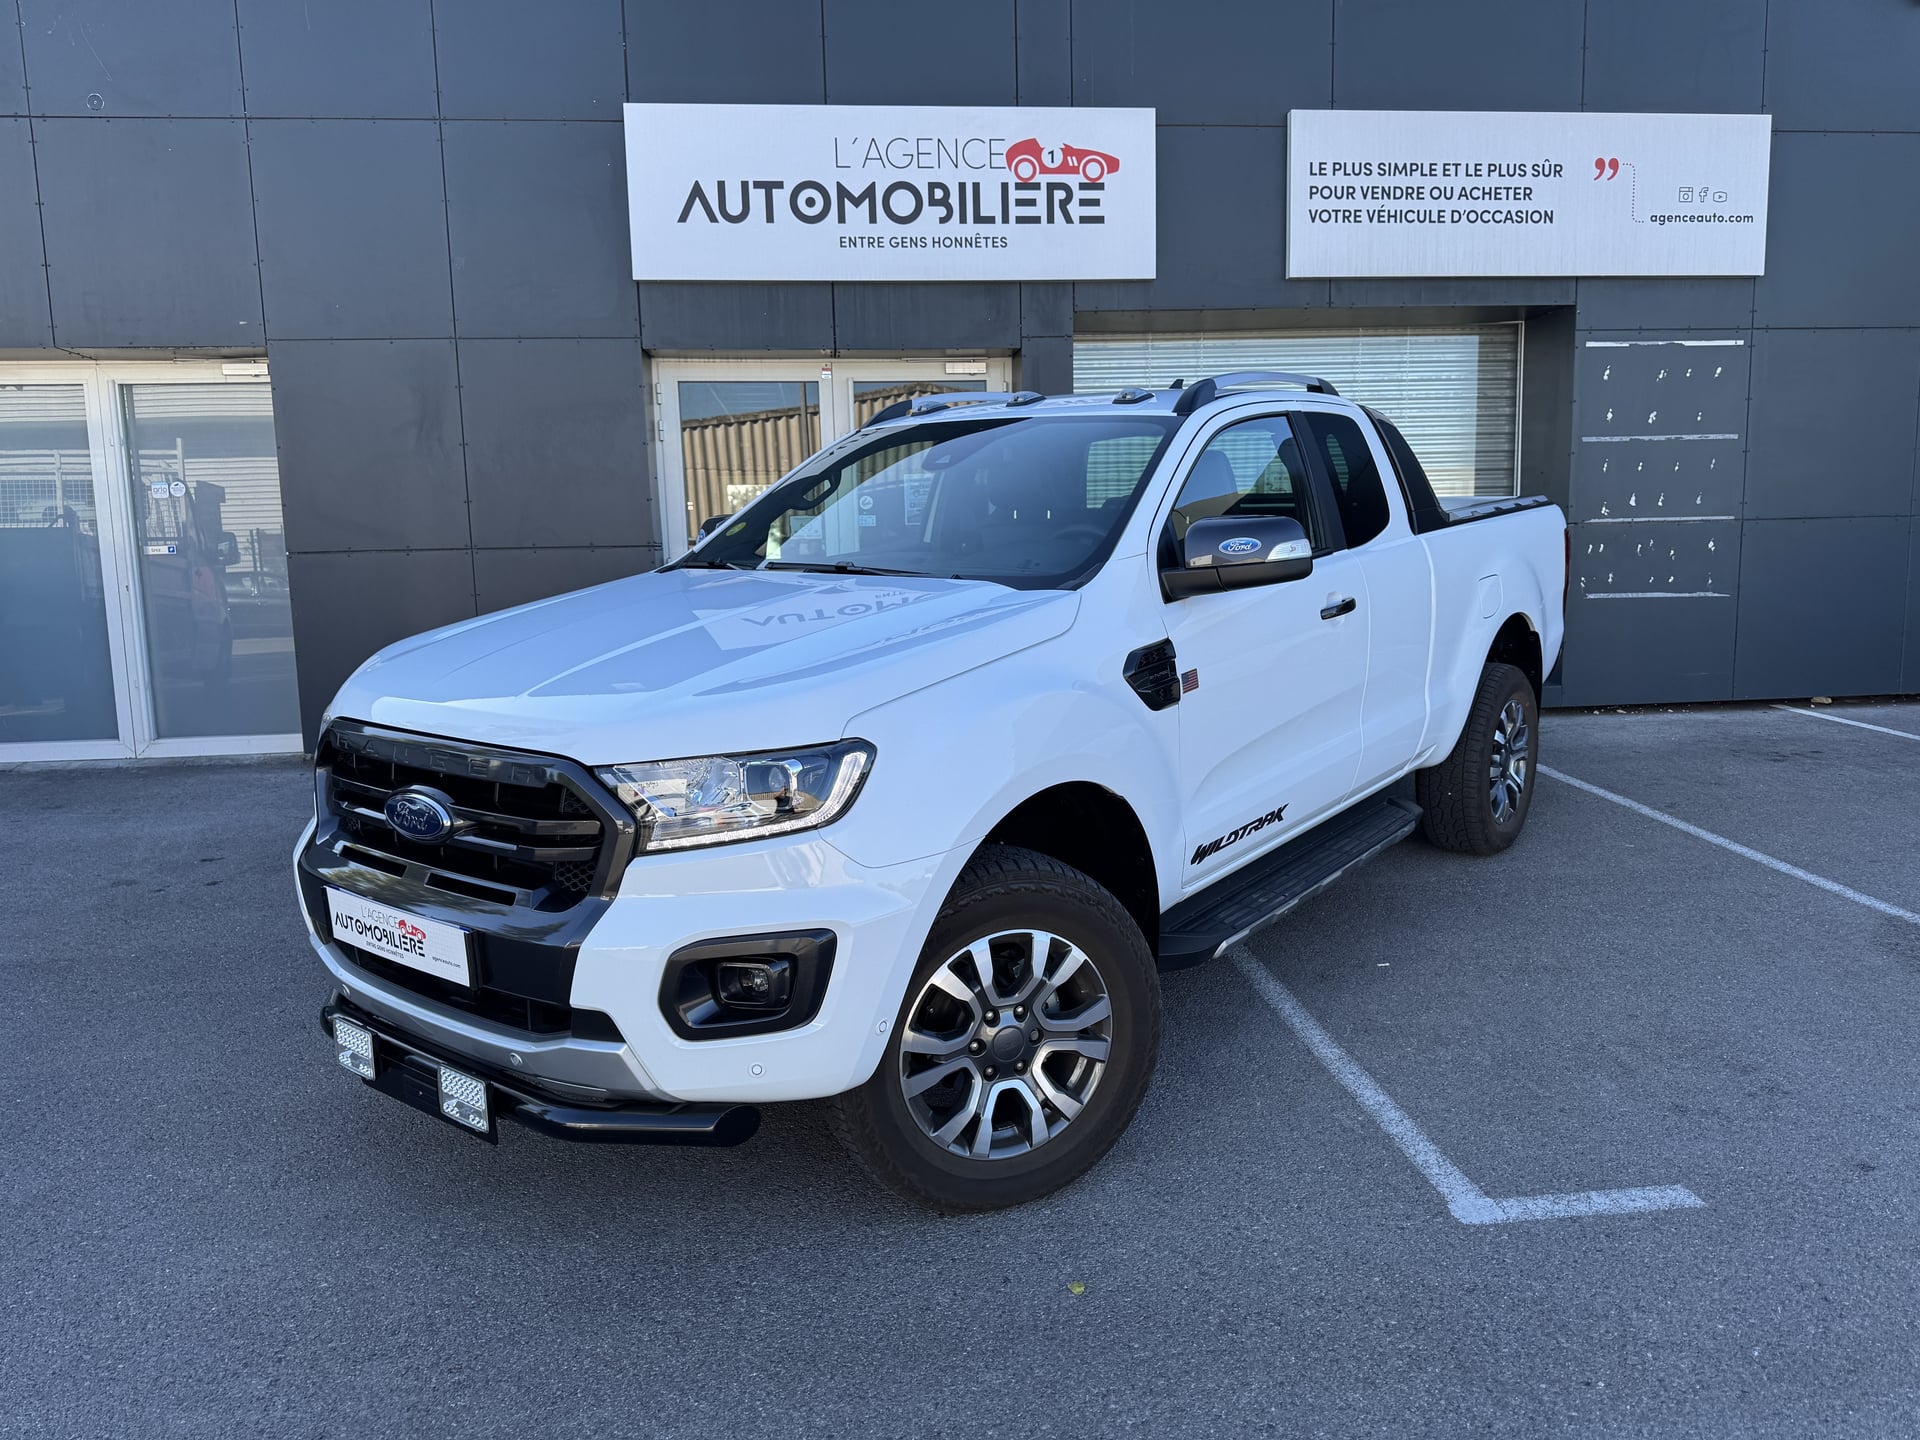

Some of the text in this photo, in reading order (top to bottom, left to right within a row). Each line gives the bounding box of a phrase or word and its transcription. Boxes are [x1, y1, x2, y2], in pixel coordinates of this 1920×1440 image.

[1048, 150, 1055, 164] 1
[1310, 159, 1563, 177] LE PLUS SIMPLE ET LE PLUS SÛR
[1310, 186, 1532, 200] POUR VENDRE OU ACHETER
[1309, 205, 1553, 224] VOTRE VÉHICULE D'OCCASION
[1650, 213, 1753, 225] agenceauto.com
[840, 233, 1007, 248] ENTRE GENS HONNÊTES
[1227, 540, 1252, 551] Ford
[1190, 803, 1289, 865] WILDTRAK
